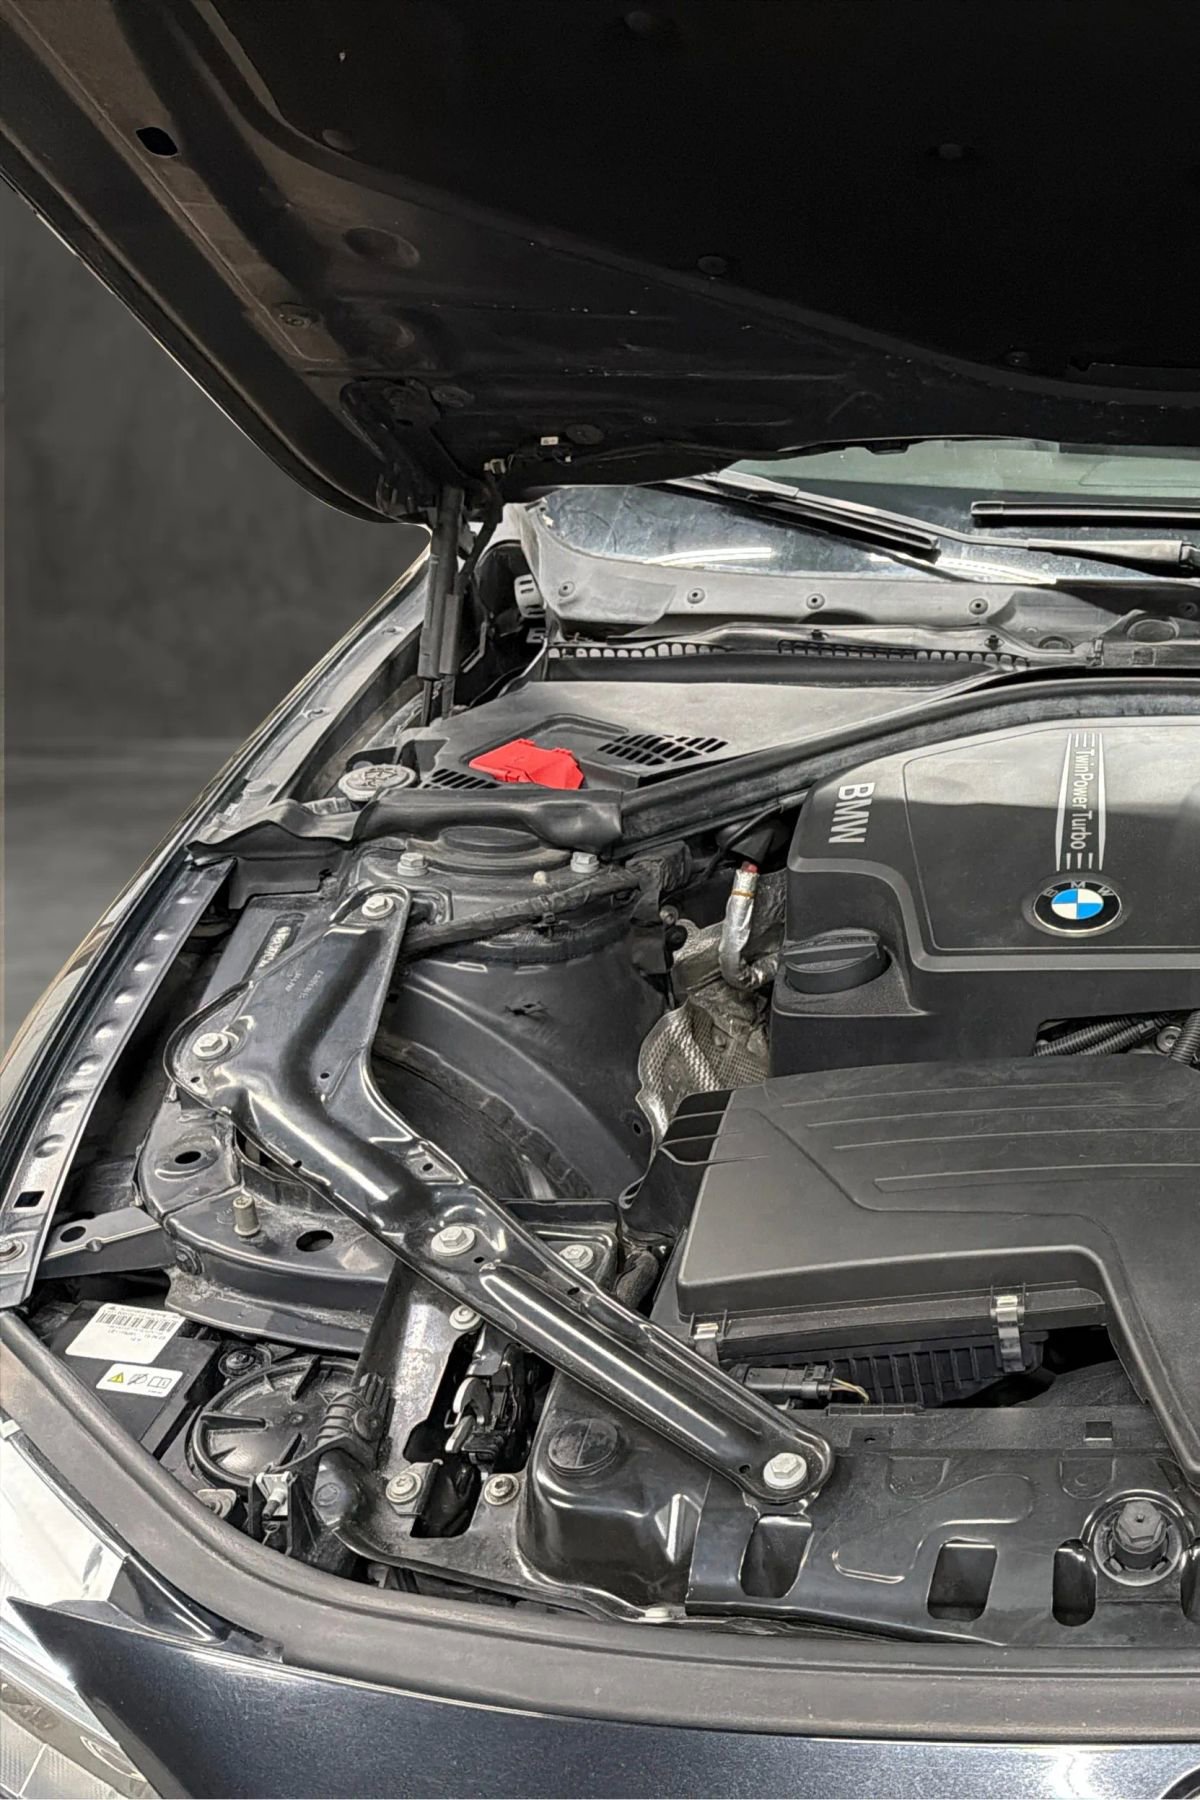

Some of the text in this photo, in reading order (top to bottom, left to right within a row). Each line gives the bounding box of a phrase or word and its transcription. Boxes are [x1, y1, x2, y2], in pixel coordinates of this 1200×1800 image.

[828, 782, 875, 843] BMW
[1070, 749, 1095, 850] TwinPower Turbo
[1041, 880, 1115, 898] BMW
